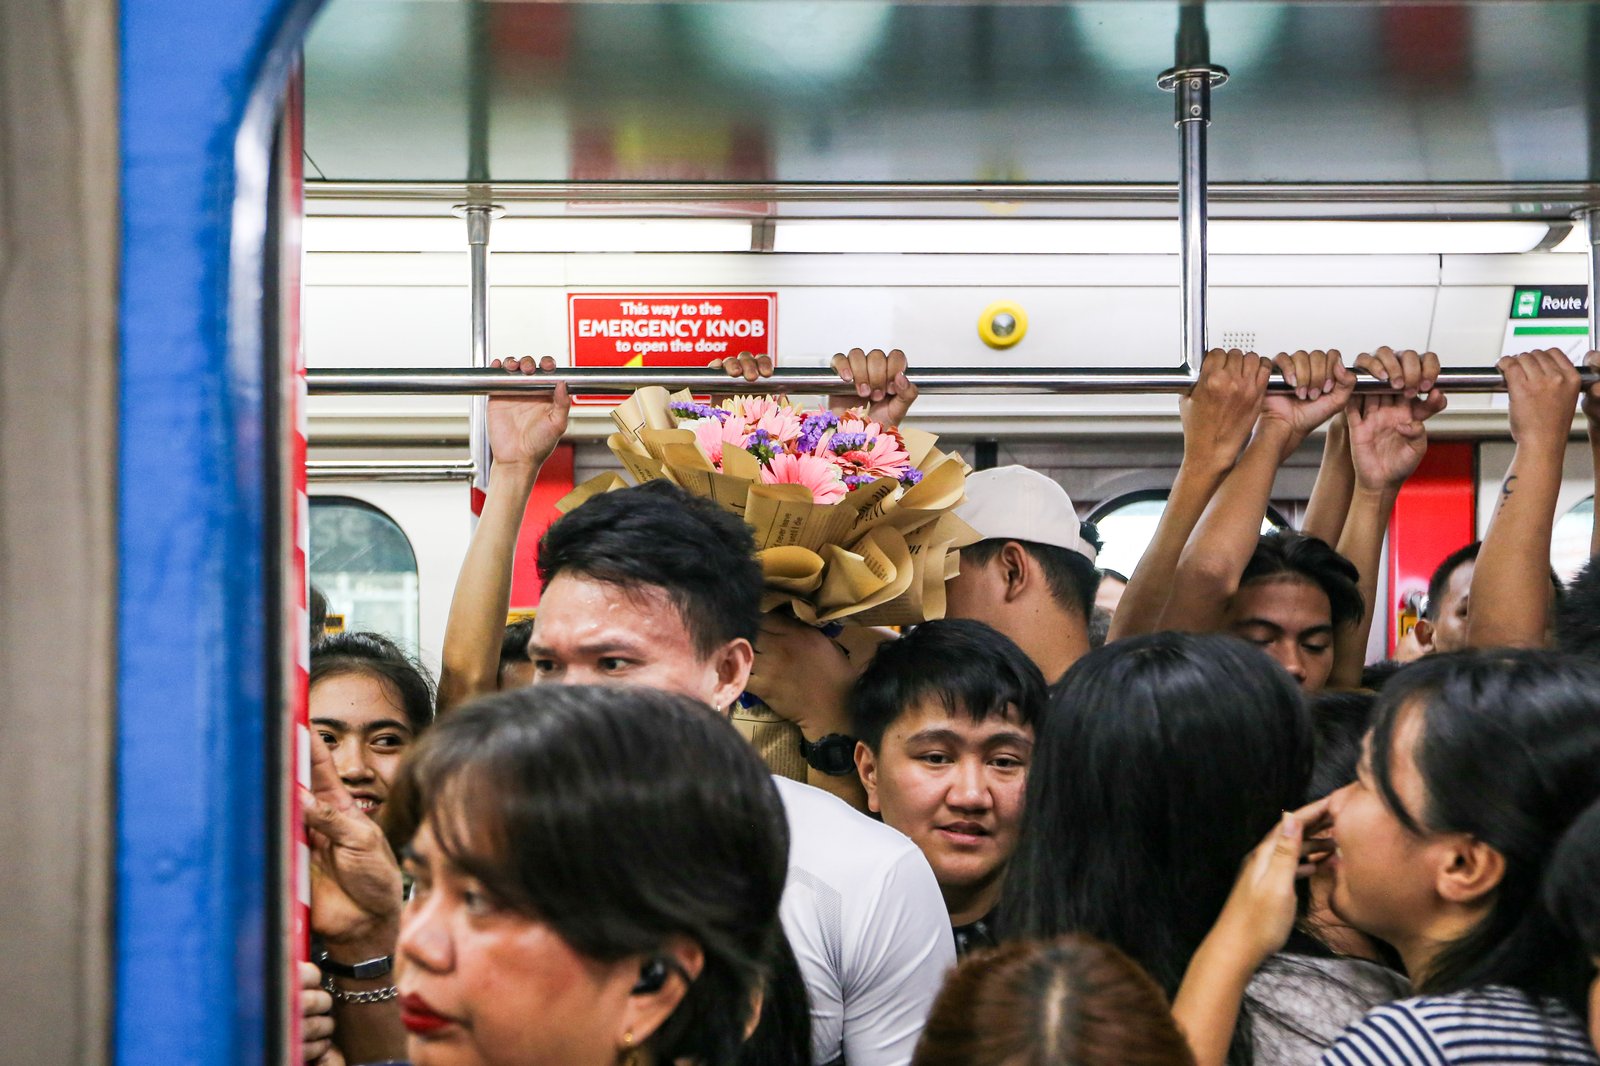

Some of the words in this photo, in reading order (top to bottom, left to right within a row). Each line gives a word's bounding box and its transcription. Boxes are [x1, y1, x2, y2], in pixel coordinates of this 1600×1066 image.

[620, 301, 649, 315] This
[651, 303, 680, 318] way
[682, 302, 697, 315] to
[698, 301, 722, 315] the
[1542, 295, 1582, 310] Route
[578, 319, 702, 337] EMERGENCY
[705, 319, 765, 337] KNOB
[615, 340, 632, 352] to
[633, 341, 668, 355] open
[670, 339, 693, 352] the
[695, 339, 728, 352] door
